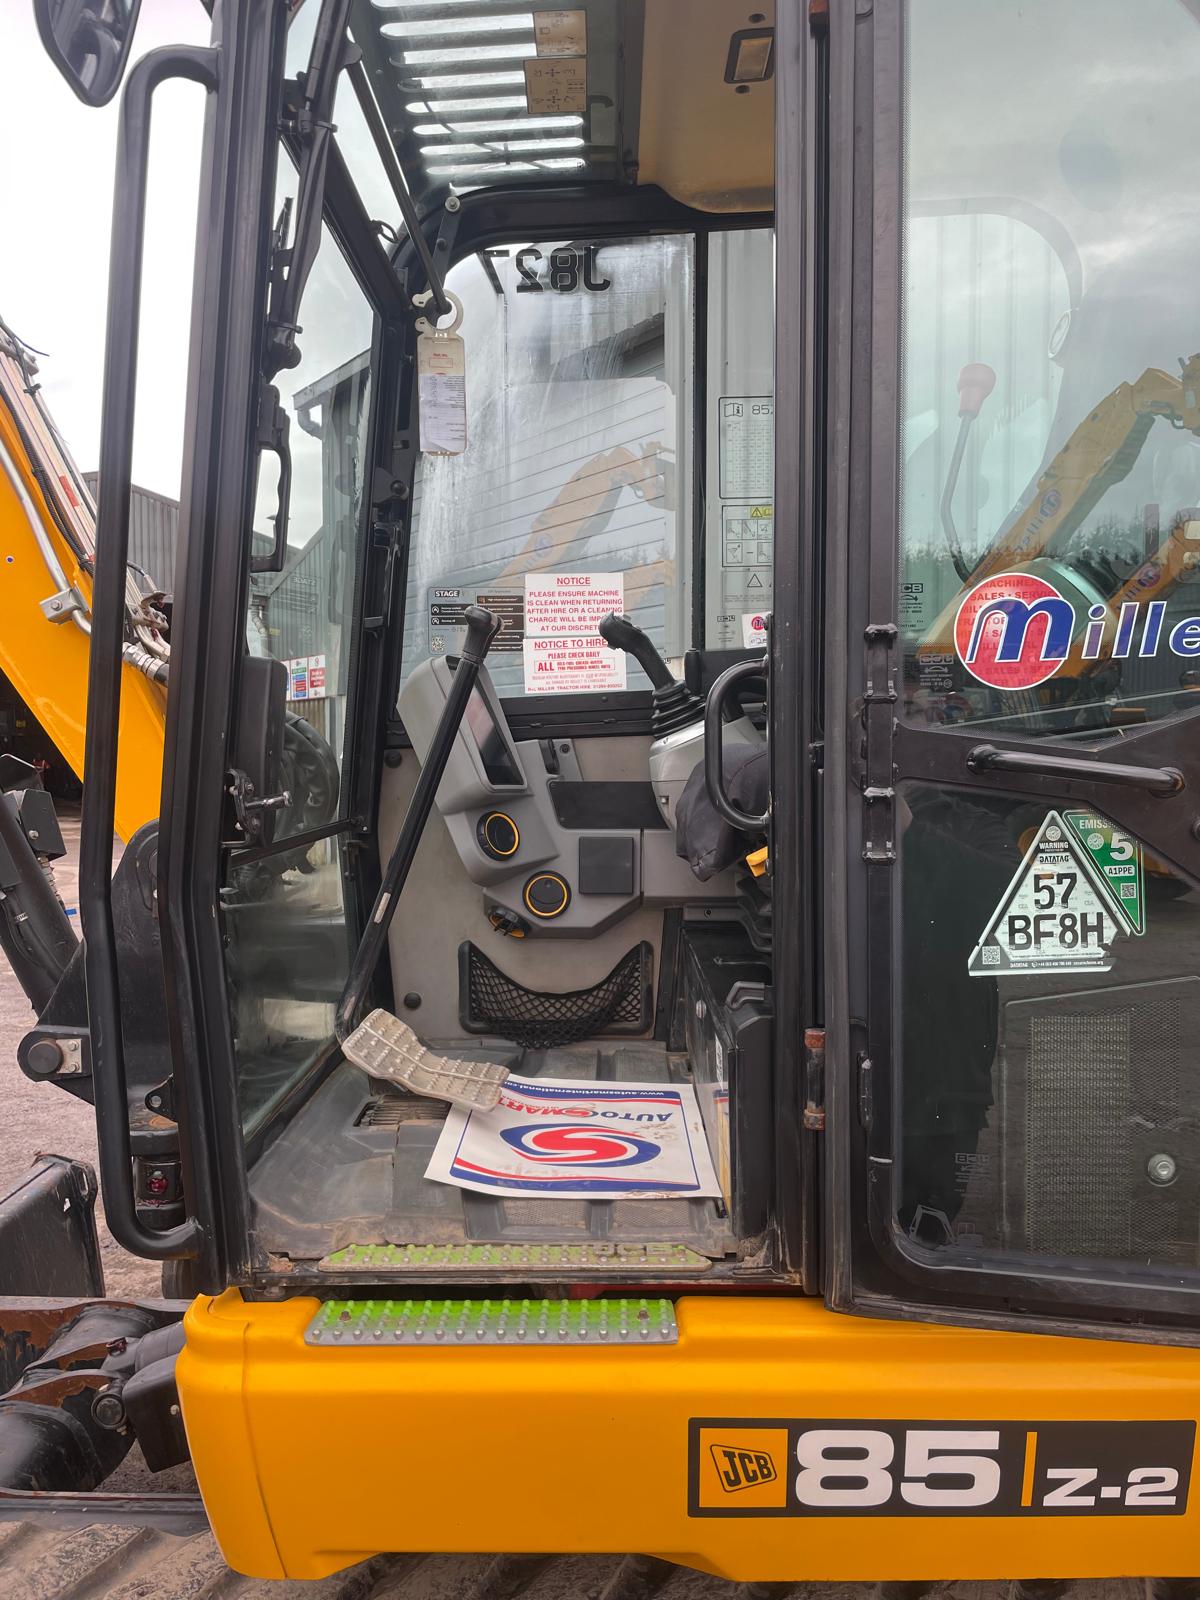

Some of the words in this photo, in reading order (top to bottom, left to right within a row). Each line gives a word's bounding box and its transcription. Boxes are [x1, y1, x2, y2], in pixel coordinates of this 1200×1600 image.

[752, 404, 773, 415] 85
[556, 577, 591, 585] NOTICE
[901, 583, 923, 593] CB
[970, 592, 1005, 601] SALES
[534, 640, 568, 649] NOTICE
[572, 639, 583, 647] TO
[538, 662, 554, 671] ALL
[1079, 818, 1109, 830] EMISS
[1109, 832, 1133, 861] 5
[1039, 855, 1070, 863] DATATAG
[1108, 866, 1133, 875] A1PPE
[1033, 872, 1078, 910] 57
[1008, 912, 1104, 951] BF8H
[721, 1448, 772, 1488] JCB
[795, 1429, 1001, 1508] 85
[1042, 1467, 1179, 1508] Z-2
